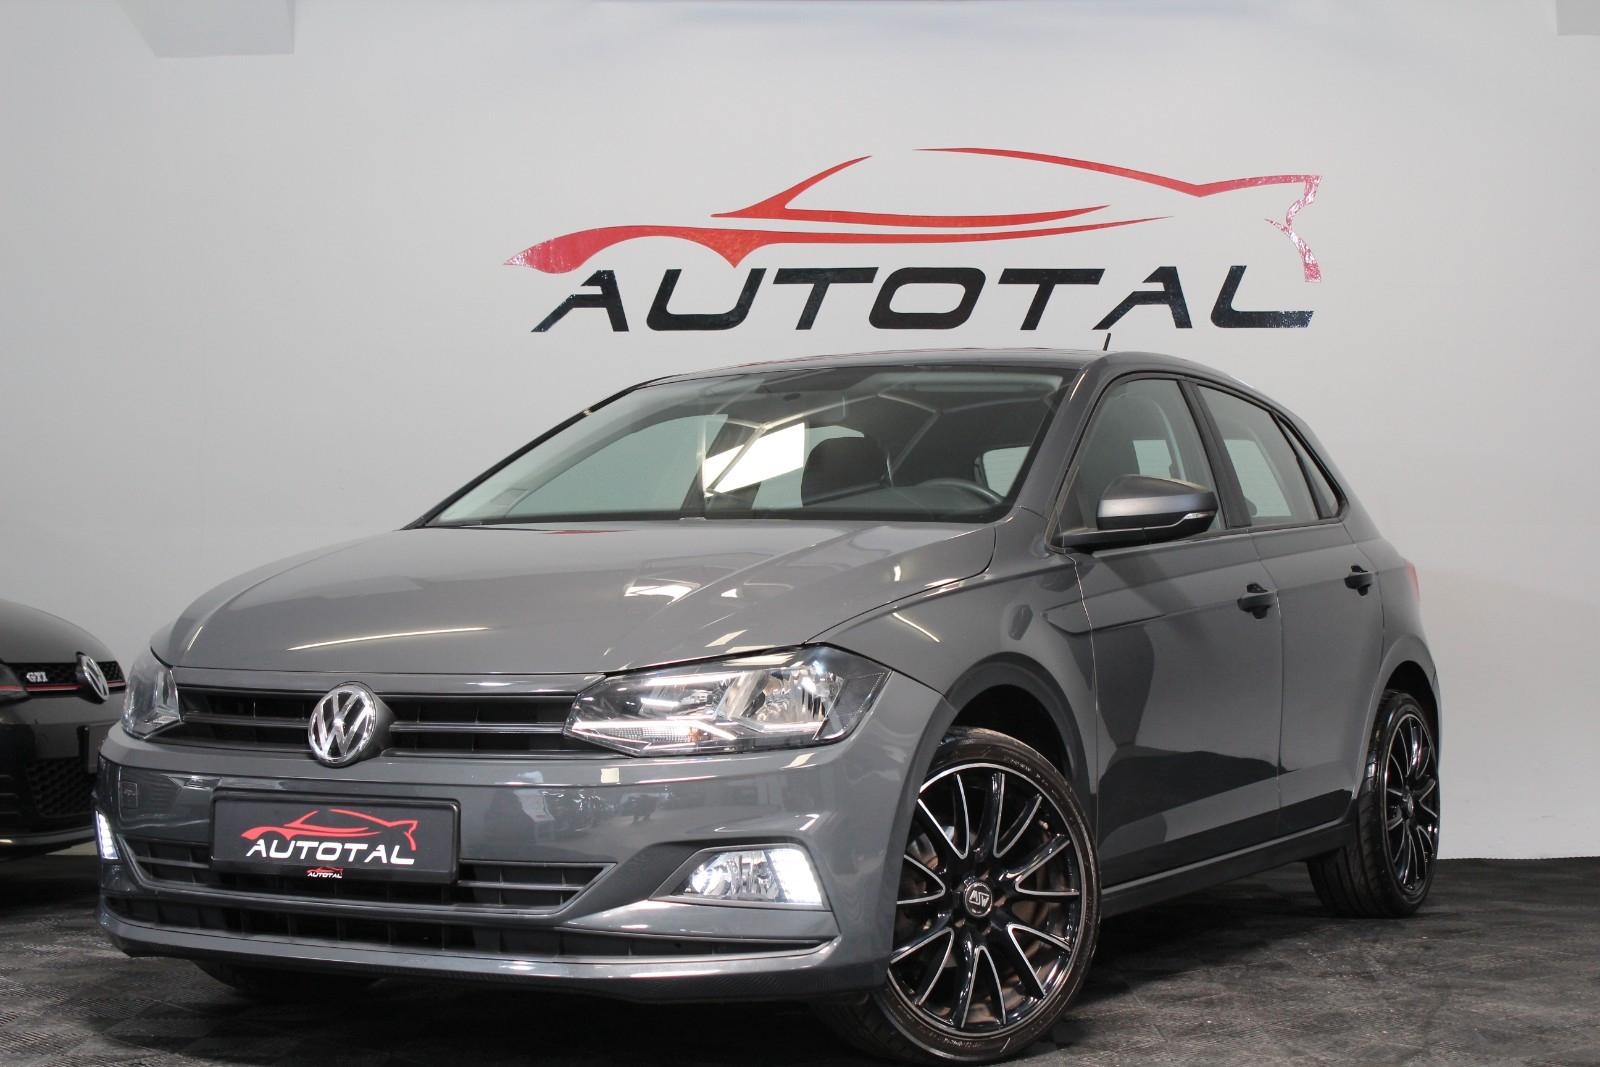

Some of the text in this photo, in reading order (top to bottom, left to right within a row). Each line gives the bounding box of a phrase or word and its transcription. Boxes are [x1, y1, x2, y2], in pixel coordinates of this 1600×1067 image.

[531, 265, 1315, 332] AUTOTAL
[26, 671, 48, 682] GTI
[246, 838, 415, 865] AUTOTAL
[307, 871, 343, 879] AUTOTAL
